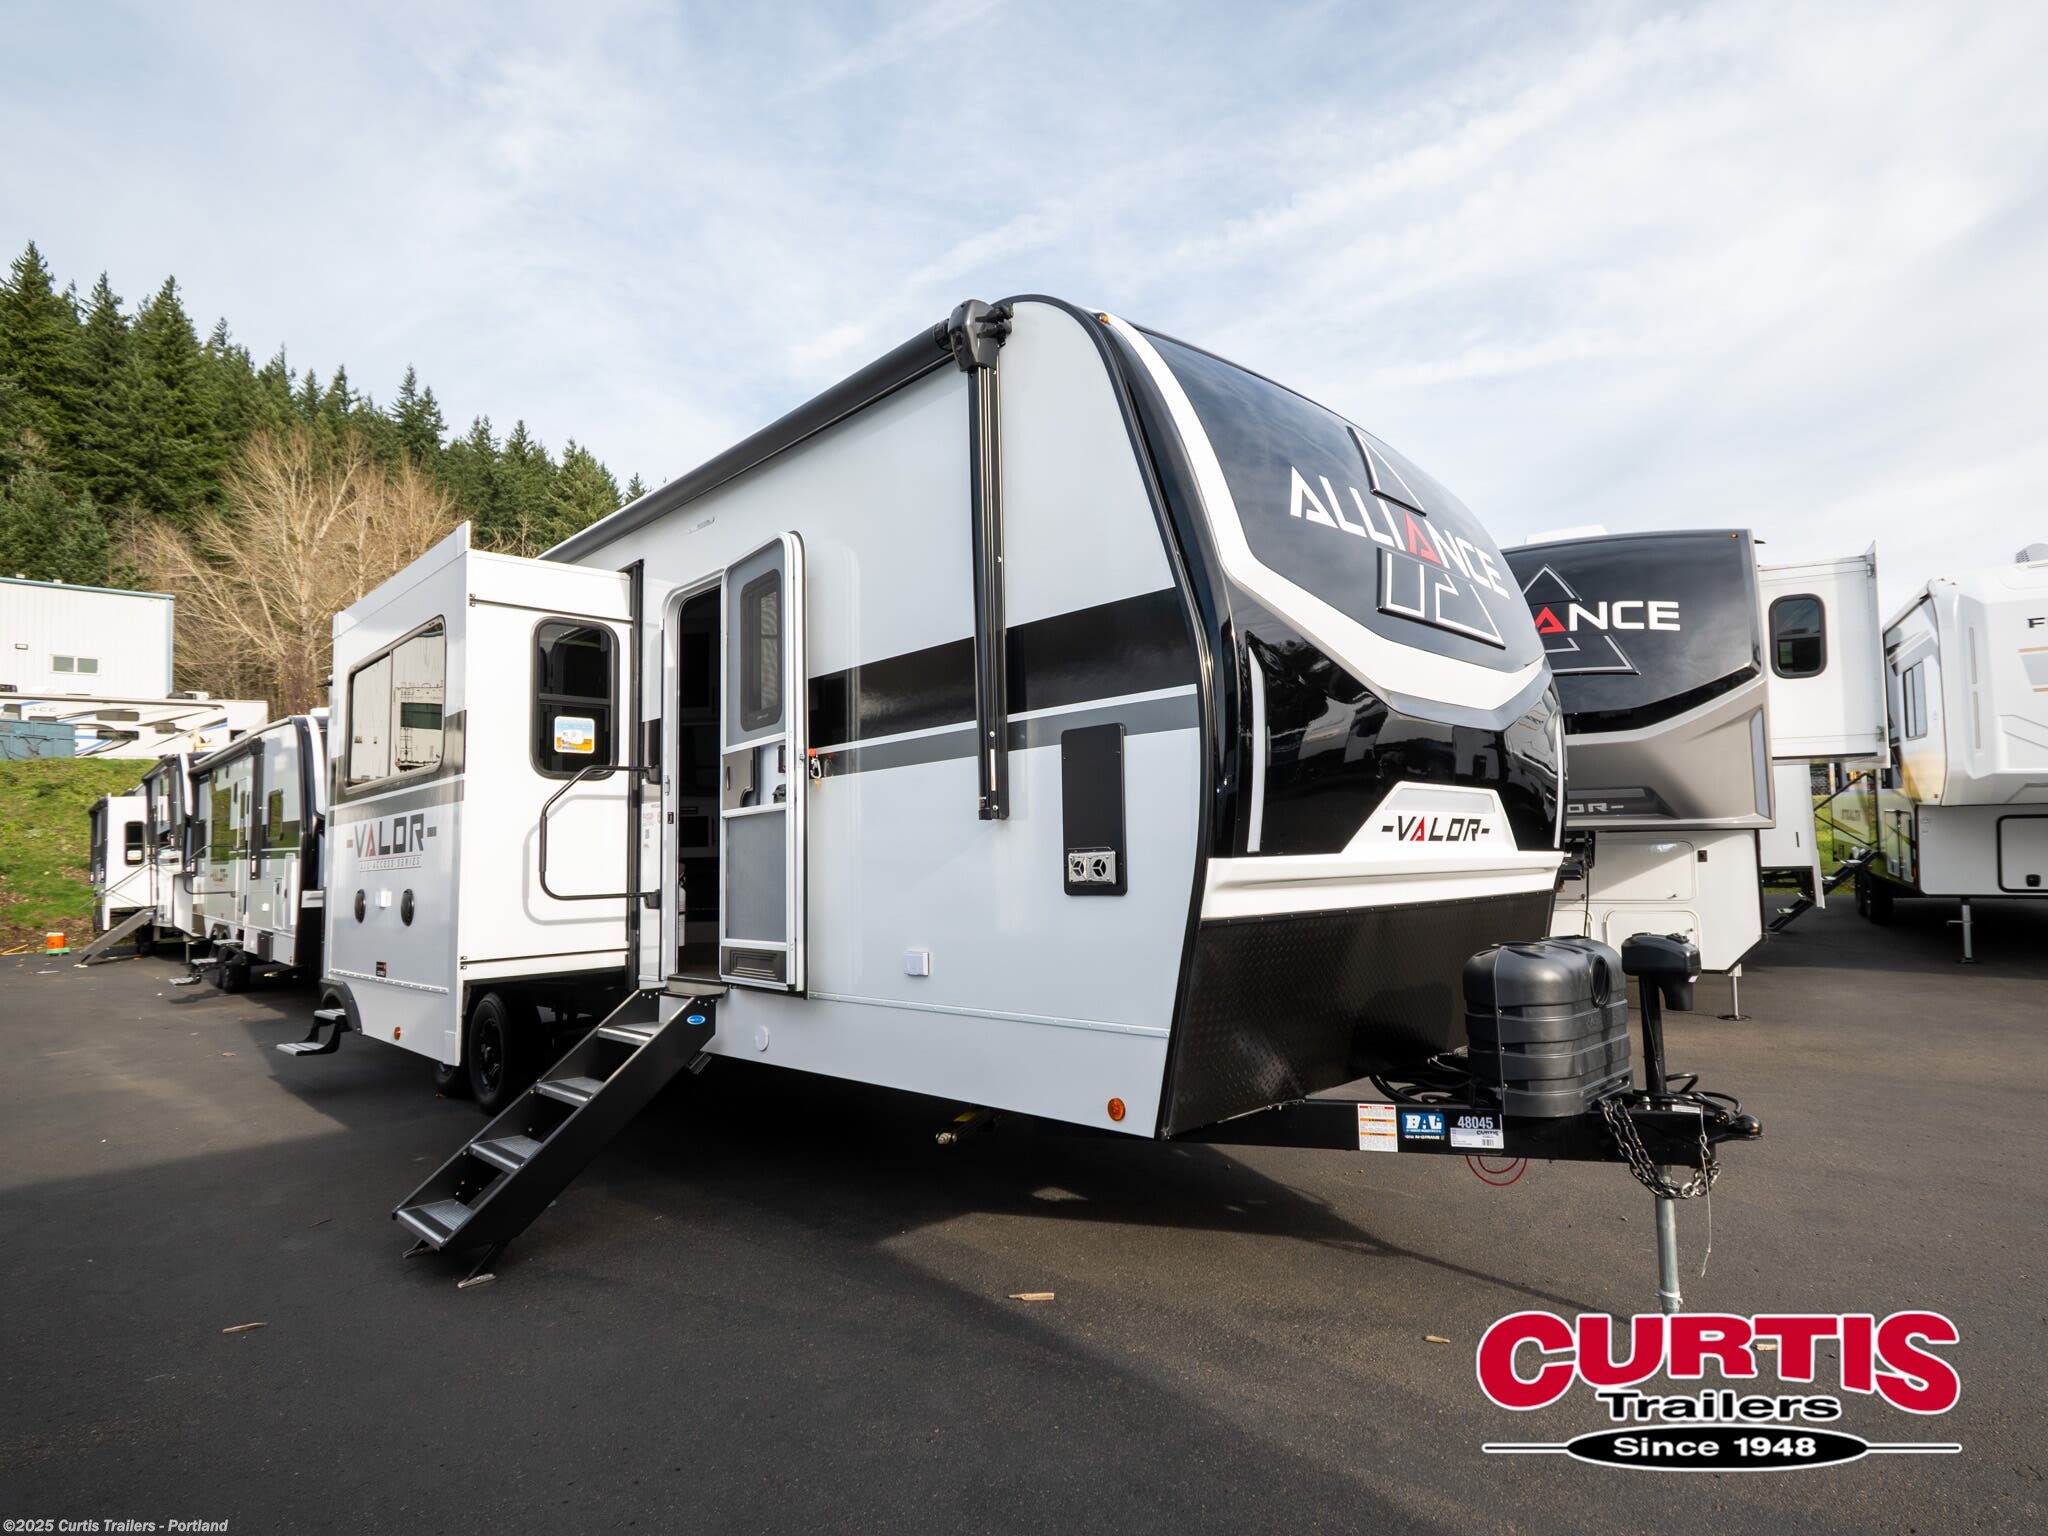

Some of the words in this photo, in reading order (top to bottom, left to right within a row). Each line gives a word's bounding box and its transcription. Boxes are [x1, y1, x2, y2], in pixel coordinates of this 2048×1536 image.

[1290, 465, 1511, 599] ALLIANCE
[1405, 1114, 1443, 1129] BAL
[1457, 1115, 1494, 1129] 48045
